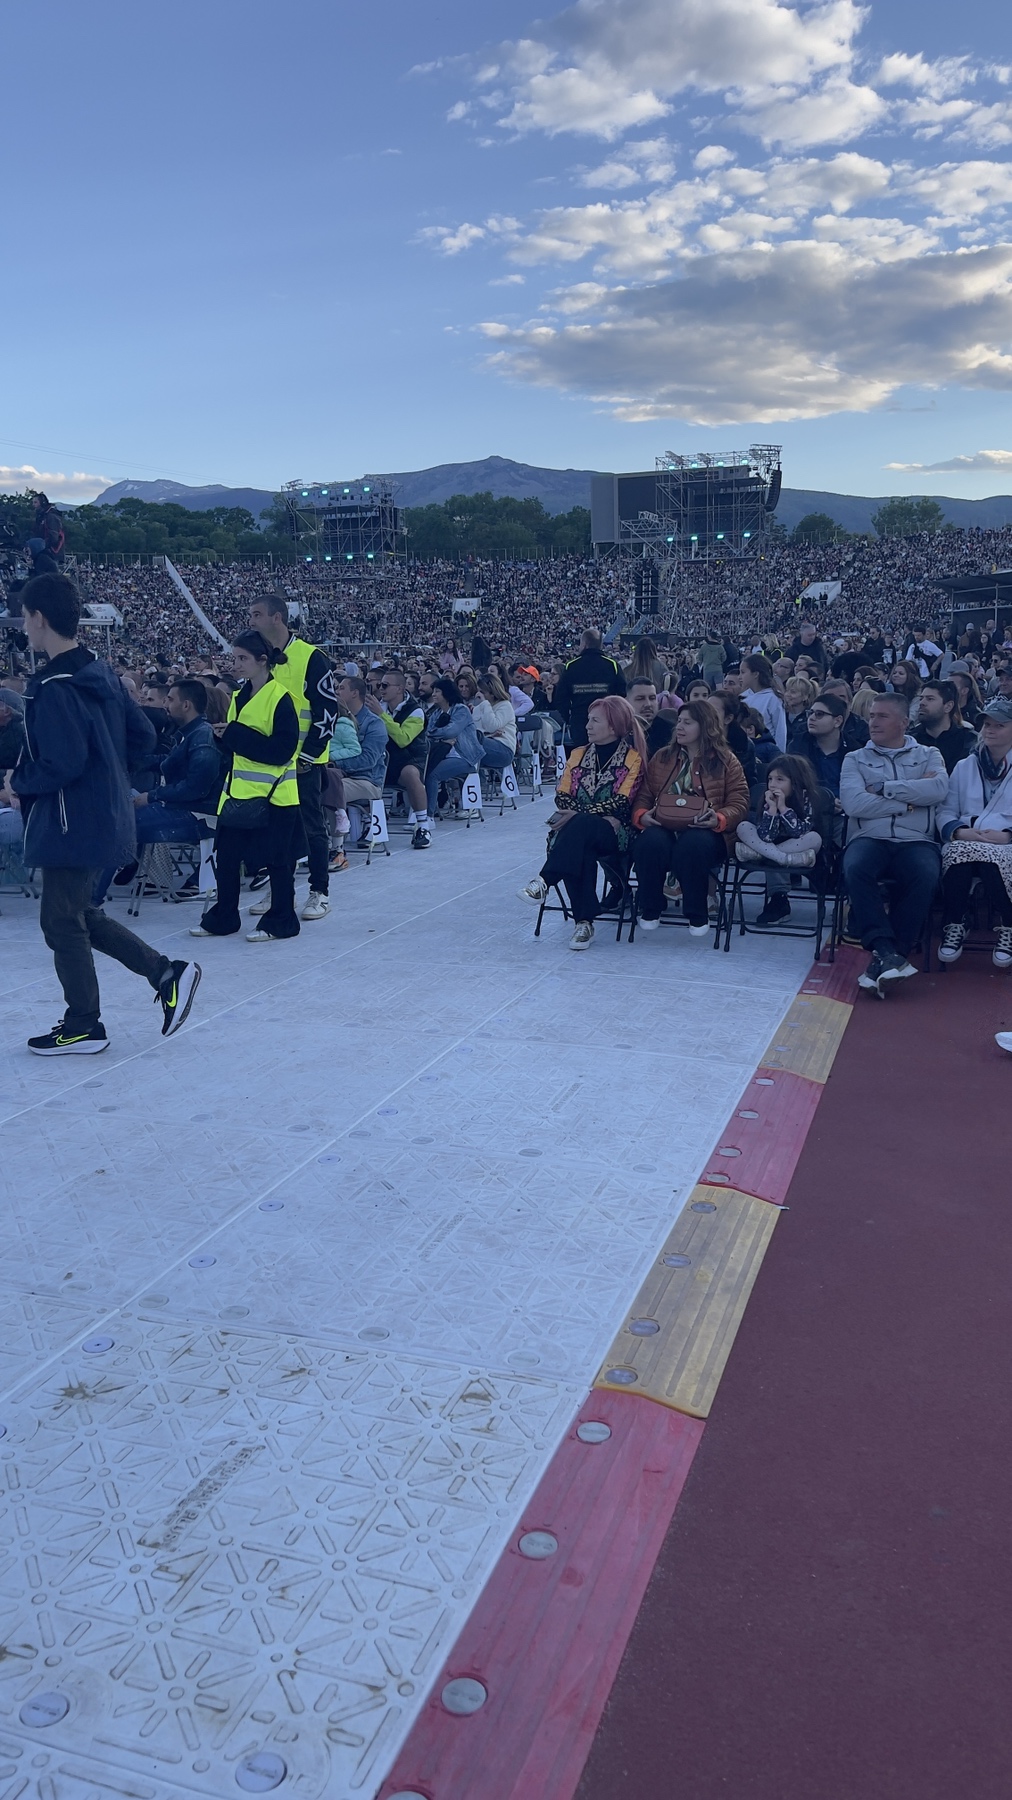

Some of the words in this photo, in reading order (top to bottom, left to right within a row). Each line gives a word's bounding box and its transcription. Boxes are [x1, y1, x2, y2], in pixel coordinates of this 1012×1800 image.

[558, 755, 565, 770] 8
[505, 775, 515, 791] 6
[467, 785, 478, 803] 5
[372, 814, 382, 836] 3
